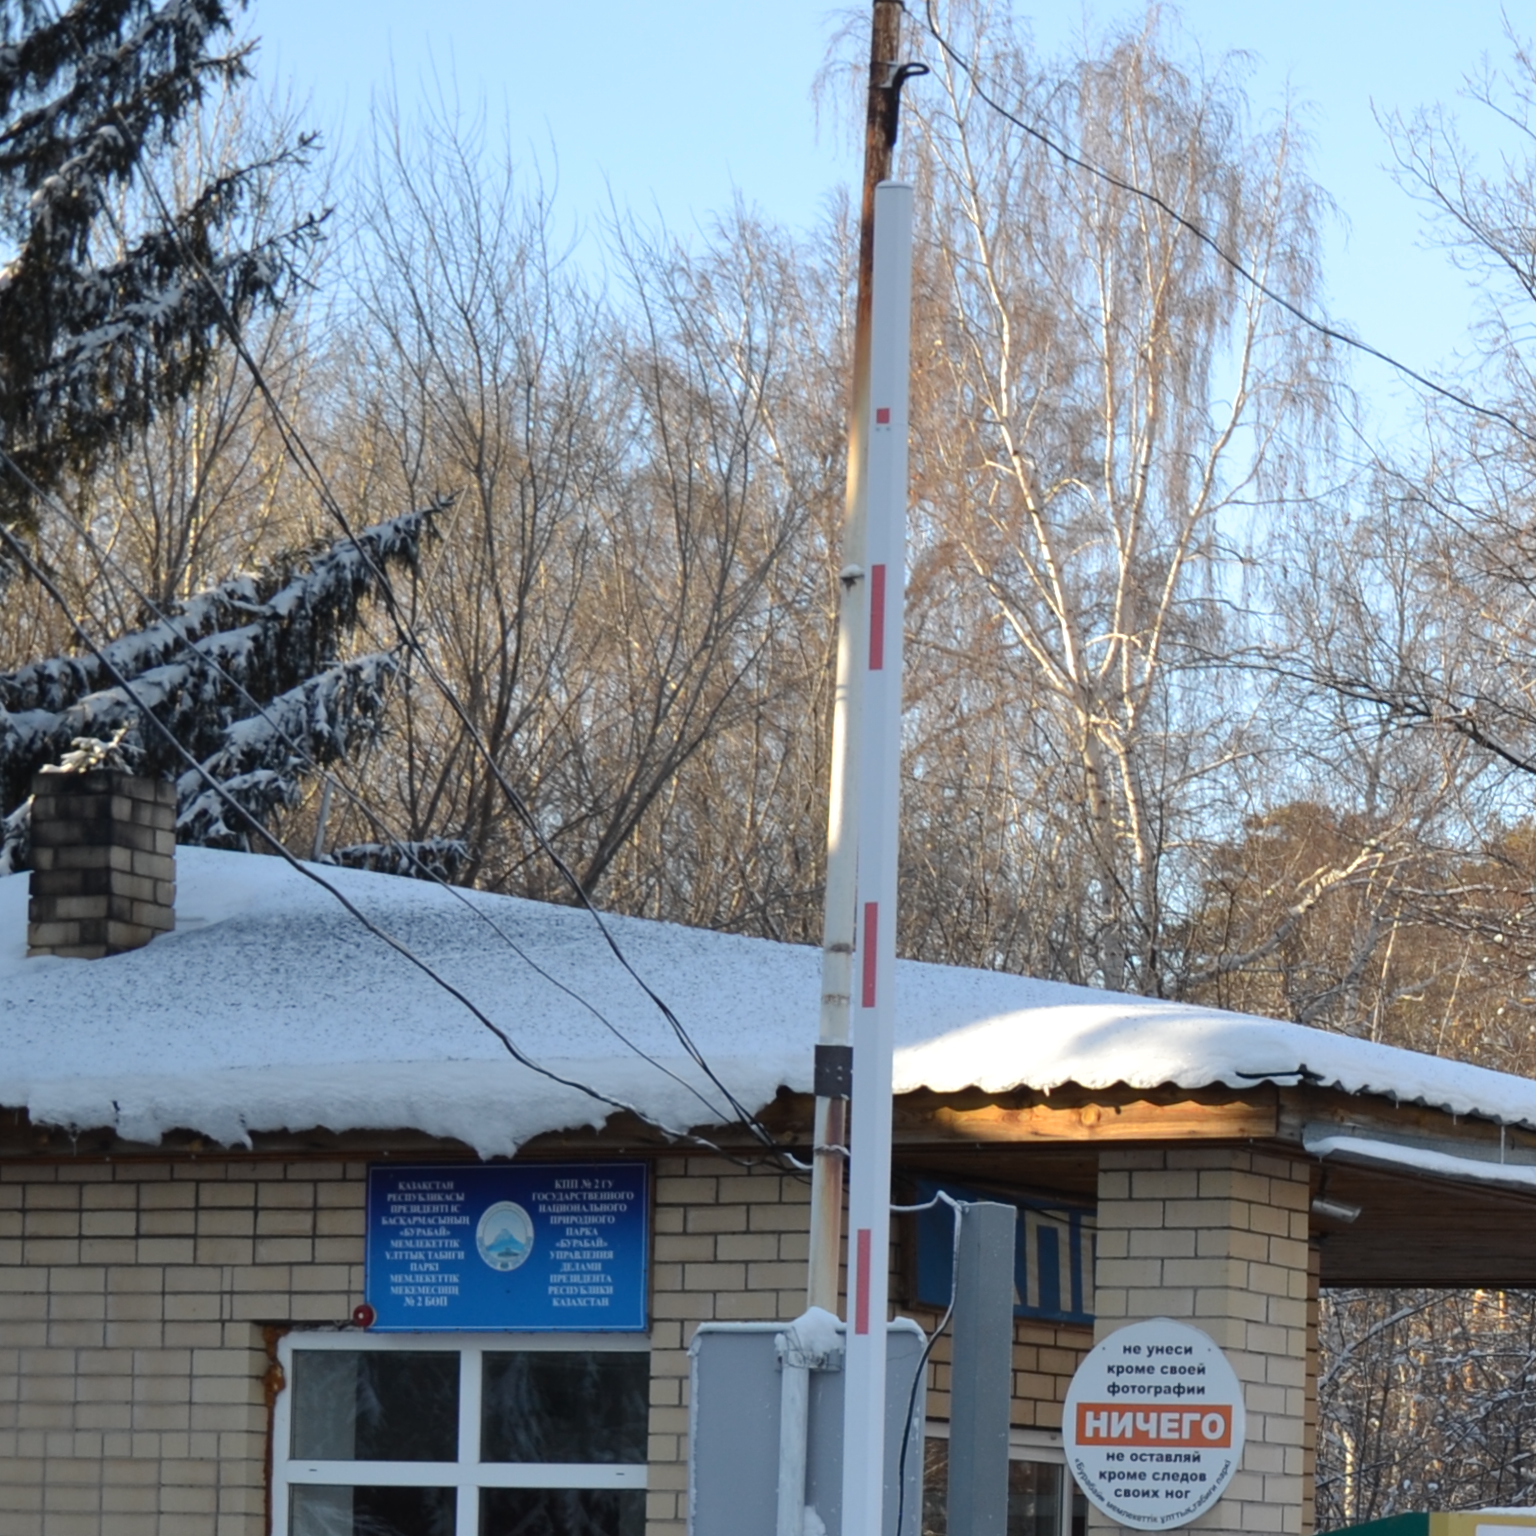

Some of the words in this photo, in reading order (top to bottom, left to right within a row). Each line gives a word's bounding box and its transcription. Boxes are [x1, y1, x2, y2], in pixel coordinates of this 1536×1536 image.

[555, 1179, 578, 1189] КПП
[594, 1179, 600, 1189] 2
[602, 1180, 614, 1189] ГУ
[387, 1193, 465, 1202] РЕСПУБЛИКАСЫ
[532, 1191, 634, 1201] ГОСУДАРСТВЕННОГО
[539, 1203, 628, 1213] НАЦИОНАЛЬНОГО
[550, 1215, 615, 1225] ПРИРОДНОГО
[566, 1227, 599, 1236] ПАРКА
[390, 1239, 460, 1248] МЕМЛЕКЕТТІК
[550, 1250, 614, 1260] УПРАВЛЕНИЯ
[410, 1263, 439, 1271] ПАРКІ
[560, 1262, 602, 1272] ДЕЛАМИ
[390, 1274, 460, 1283] МЕМЛЕКЕТТІК
[550, 1274, 612, 1283] ПРЕЗИДЕНТА
[548, 1286, 613, 1295] РЕСПУБЛИКИ
[417, 1296, 423, 1306] 2
[553, 1297, 609, 1307] КАЗАХСТАН
[1123, 1345, 1141, 1355] не
[1146, 1345, 1193, 1358] унеси
[1107, 1364, 1155, 1376] кроме
[1160, 1363, 1206, 1375] своей
[1107, 1382, 1206, 1398] фотографии
[1084, 1411, 1226, 1441] НИЧЕГО
[1106, 1452, 1125, 1462] не
[1130, 1451, 1201, 1463] оставляй
[1099, 1470, 1147, 1483] кроме
[1152, 1471, 1207, 1483] следов
[1114, 1488, 1160, 1499] своих
[1165, 1489, 1191, 1499] ног
